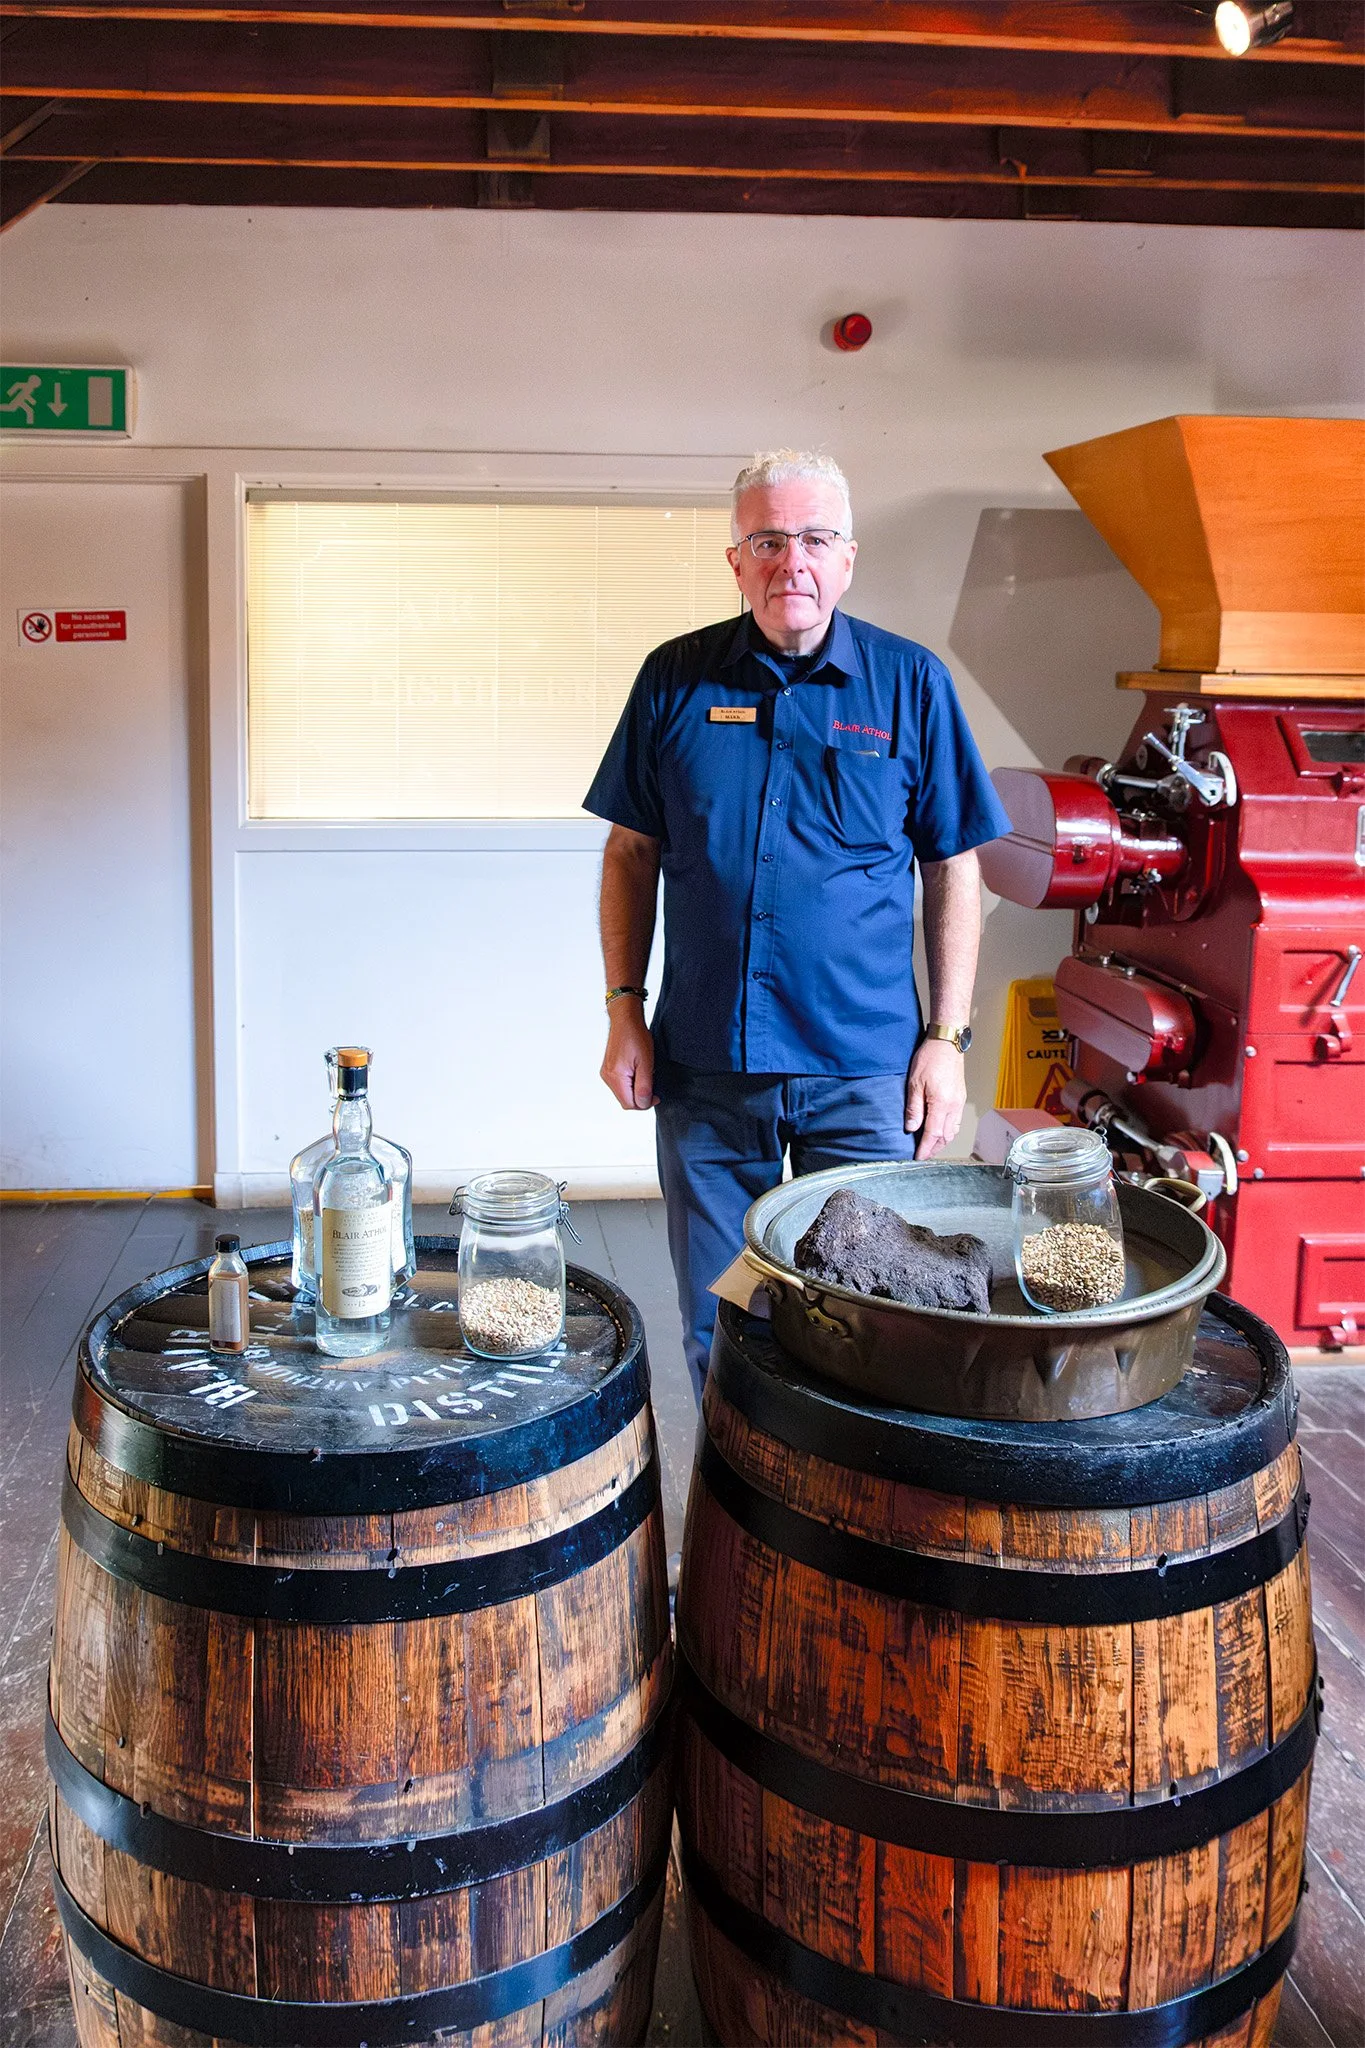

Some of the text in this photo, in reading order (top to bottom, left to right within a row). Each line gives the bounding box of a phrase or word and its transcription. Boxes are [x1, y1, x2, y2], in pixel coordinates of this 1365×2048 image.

[71, 613, 83, 621] No
[73, 631, 110, 639] personnel
[832, 719, 892, 741] BLAIR ATHOL
[1026, 1049, 1066, 1059] CAUTI
[332, 1229, 360, 1240] BLAIR
